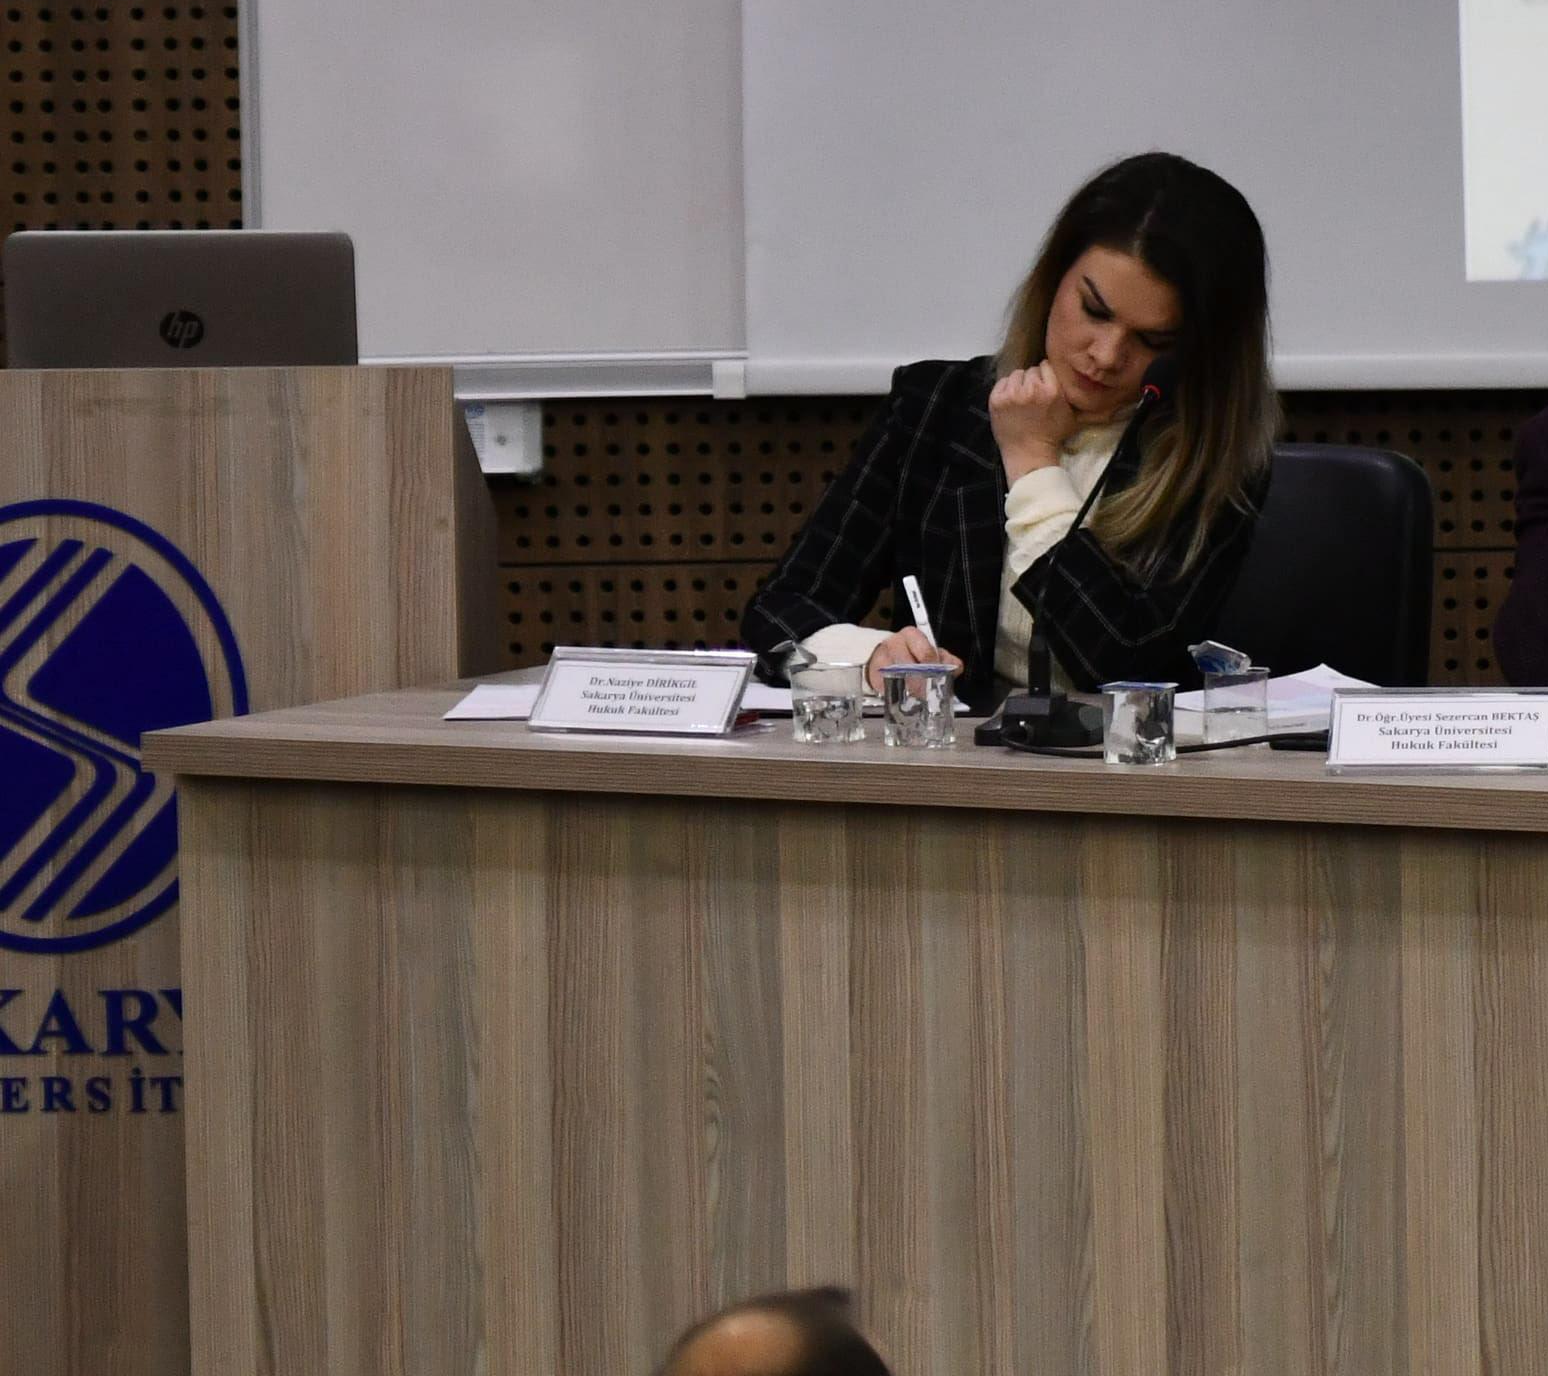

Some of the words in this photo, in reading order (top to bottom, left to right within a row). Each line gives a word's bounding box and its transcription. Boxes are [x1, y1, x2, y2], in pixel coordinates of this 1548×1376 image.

[167, 311, 200, 351] hp
[581, 690, 626, 702] Sakarya
[628, 691, 696, 703] Üniversitesi
[586, 704, 625, 715] Hukuk
[627, 705, 680, 716] Fakültesi
[1434, 713, 1489, 722] Sezercan
[1491, 712, 1540, 723] BEKTAŞ
[1378, 726, 1431, 737] Sakarya
[1434, 725, 1513, 736] Üniversitesi
[1391, 739, 1435, 750] Hukuk
[1438, 739, 1499, 750] Fakültesi
